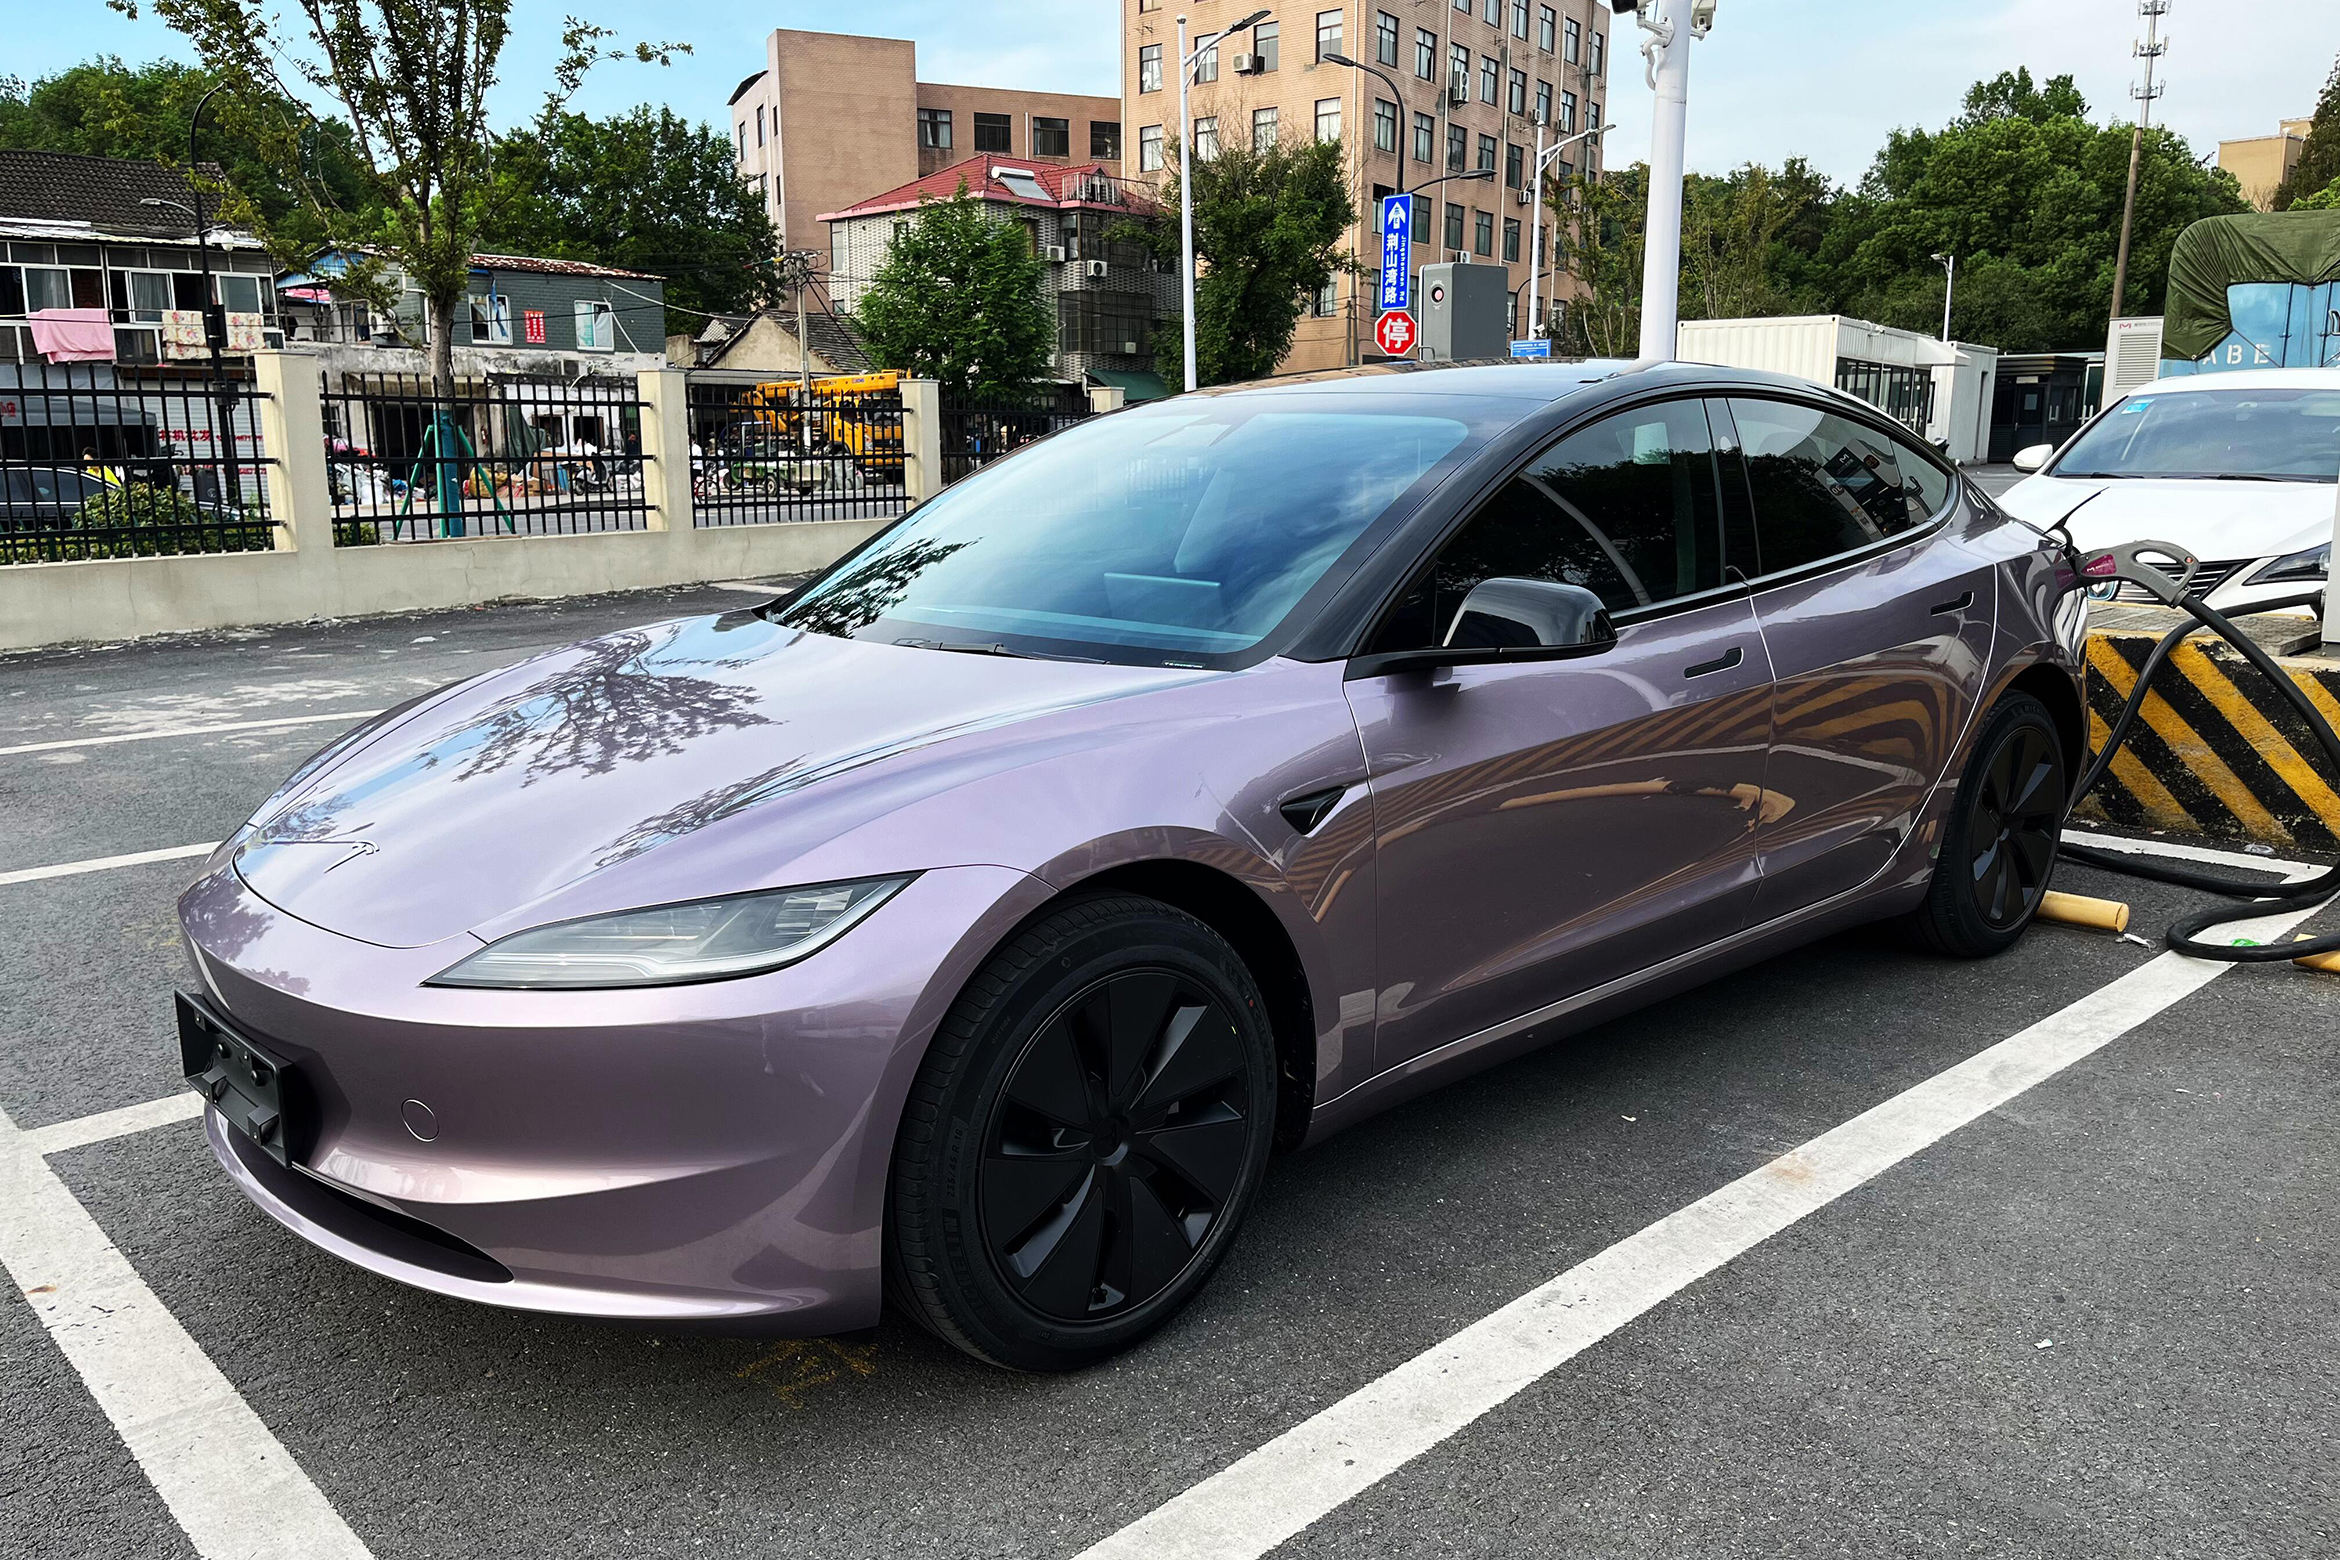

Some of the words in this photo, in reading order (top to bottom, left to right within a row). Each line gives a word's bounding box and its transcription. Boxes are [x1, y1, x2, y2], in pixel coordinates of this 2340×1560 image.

[1384, 232, 1398, 304] 荆山湾路
[1382, 317, 1409, 348] 停
